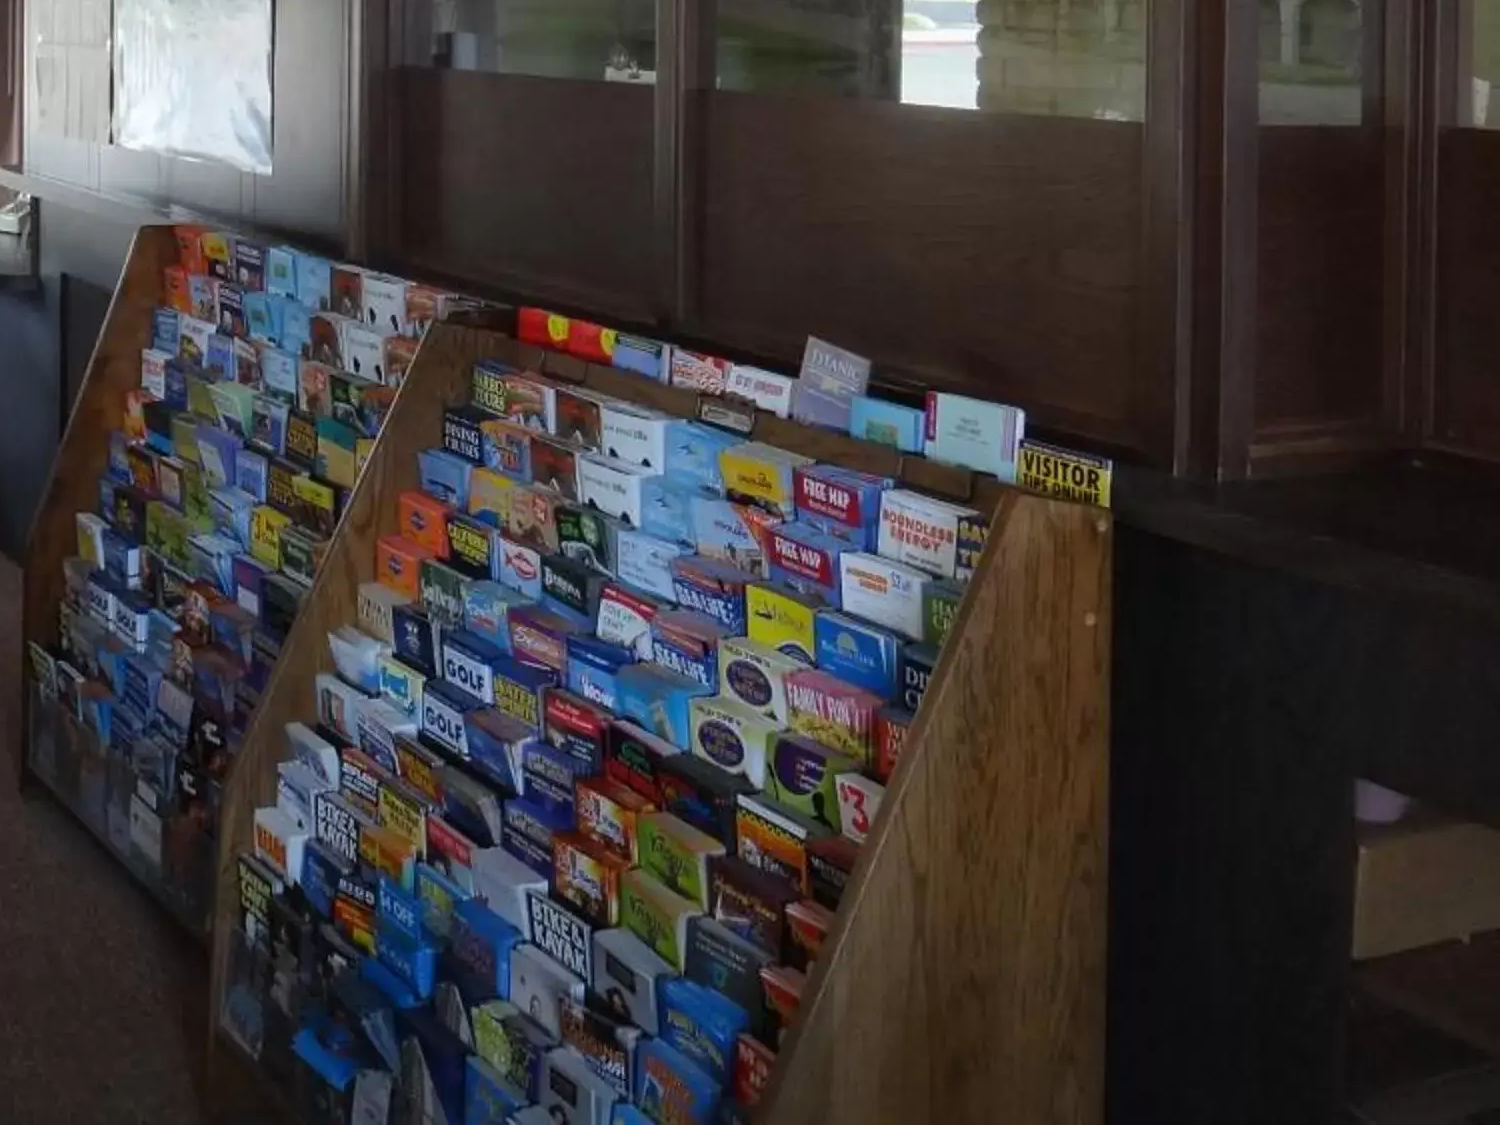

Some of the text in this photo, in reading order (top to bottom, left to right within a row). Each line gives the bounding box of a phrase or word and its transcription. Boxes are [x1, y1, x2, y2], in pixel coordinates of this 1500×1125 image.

[803, 477, 828, 499] FREE
[1023, 452, 1100, 491] VISITOR
[1023, 474, 1050, 492] TIPS
[883, 508, 954, 544] BOUNDLESS
[890, 525, 942, 553] ENERGY
[446, 661, 485, 693] GOLF
[652, 640, 711, 690] SEA LIFE
[426, 709, 463, 741] GOLF
[318, 818, 358, 863] KAYAK
[532, 896, 573, 939] BIKE
[534, 920, 588, 973] KAYAK
